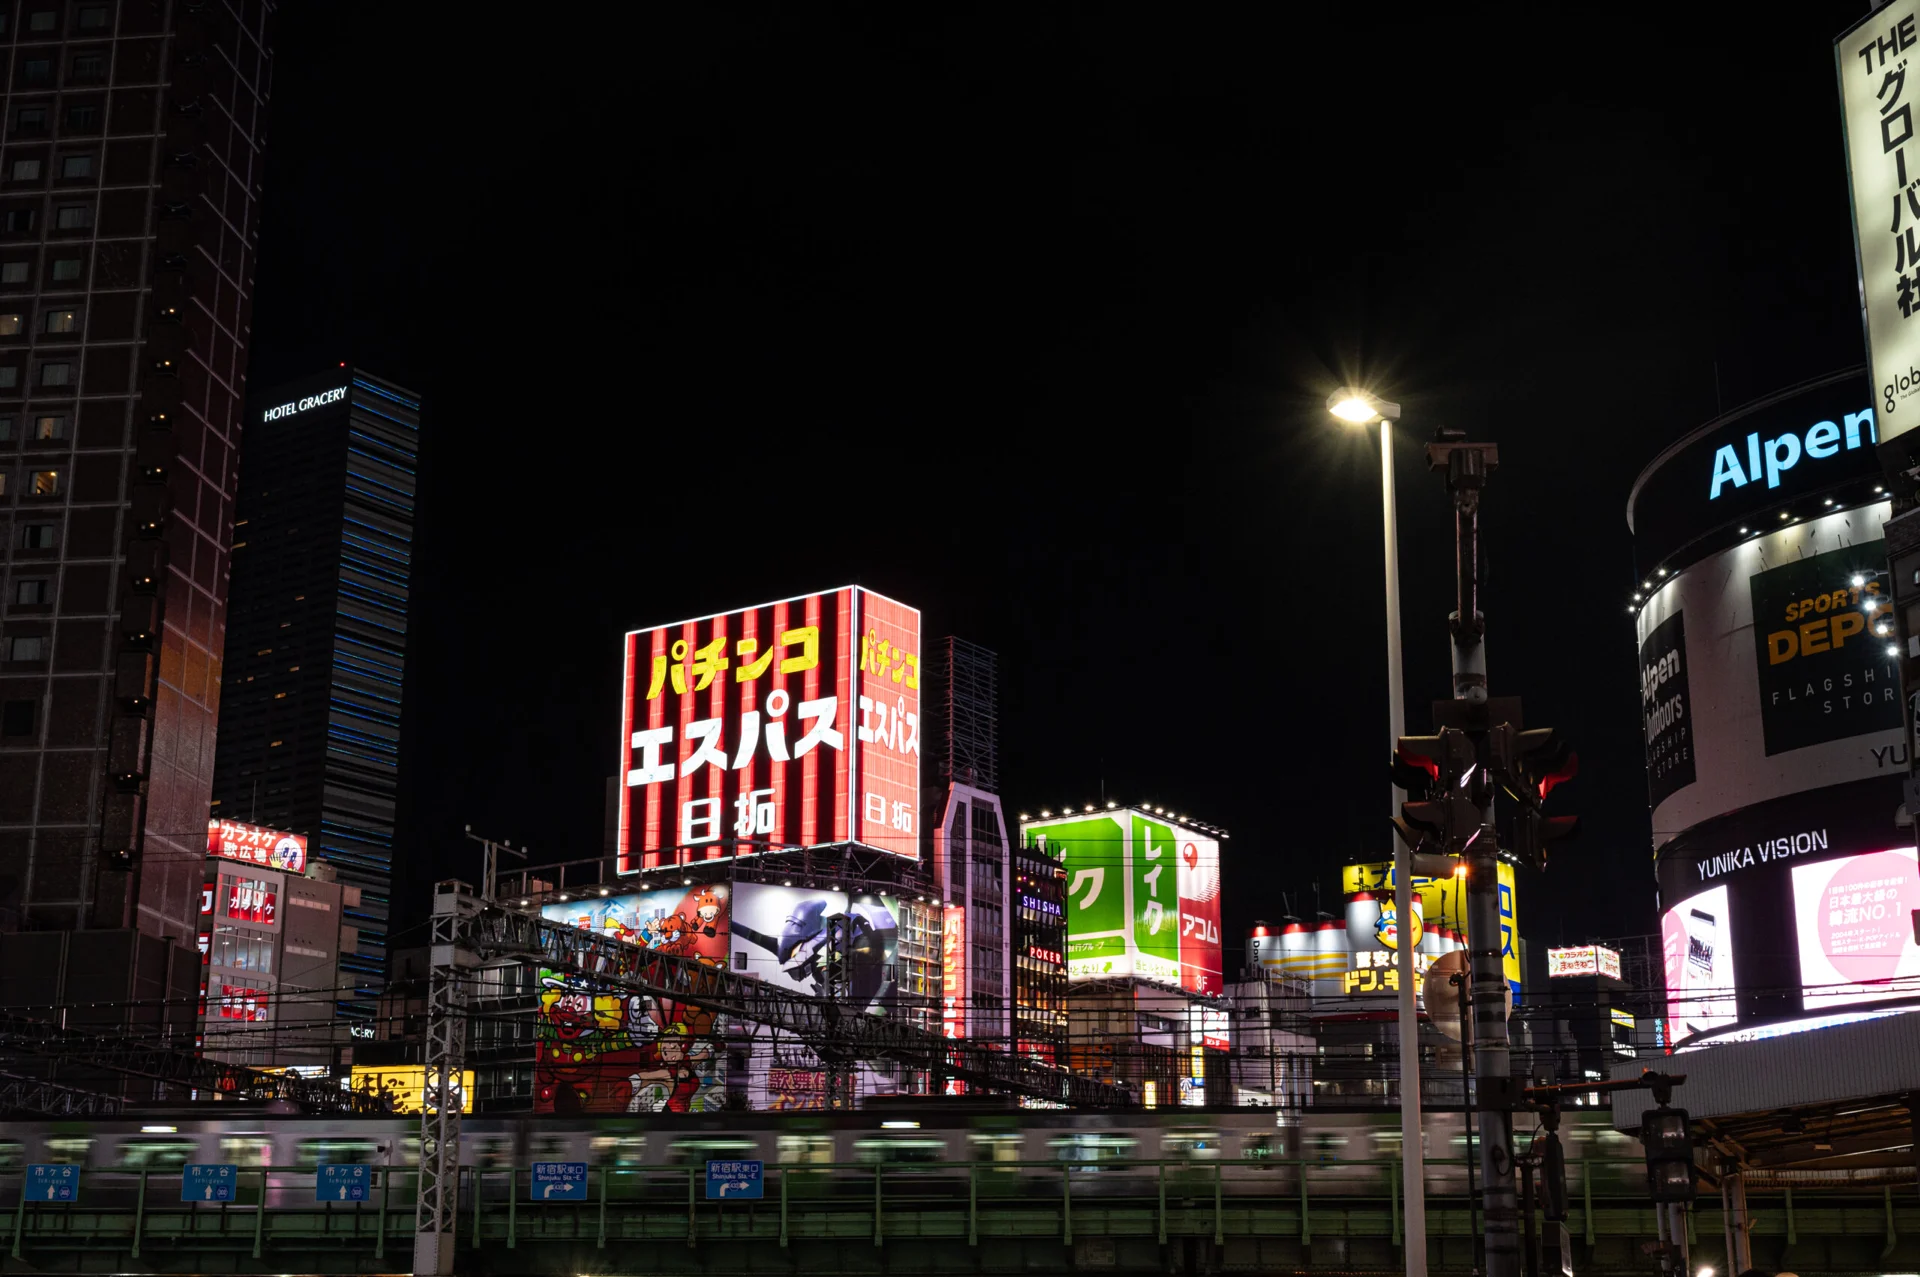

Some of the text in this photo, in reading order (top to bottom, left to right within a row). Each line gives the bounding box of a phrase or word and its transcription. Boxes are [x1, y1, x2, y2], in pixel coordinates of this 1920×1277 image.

[1859, 13, 1917, 75] THE
[264, 386, 348, 422] HOTEL GRACERY
[1710, 408, 1876, 500] Alpen
[1785, 582, 1880, 622] SPORTS
[646, 625, 819, 700] パチンコ
[860, 628, 918, 690] パチンコ
[1642, 649, 1681, 706] Alpen
[858, 695, 919, 758] エスパス
[1646, 693, 1683, 745] Outdoors
[627, 689, 844, 787] エスパス
[1657, 747, 1689, 778] STORE
[682, 788, 776, 845] 日拓
[221, 823, 277, 848] カラオケ
[223, 842, 267, 863] 歌広場
[1757, 829, 1828, 863] VISION
[1144, 826, 1163, 935] レイク
[230, 897, 275, 915] カラオケ
[1024, 896, 1061, 915] SHISHA
[1182, 912, 1219, 944] アコム
[944, 918, 957, 991] パチンコ
[1030, 946, 1061, 964] POKER
[1560, 960, 1594, 972] まねきねこ
[1196, 975, 1208, 992] 3F
[537, 1164, 584, 1174] 新宿駅東口
[711, 1163, 758, 1173] 新宿駅東口
